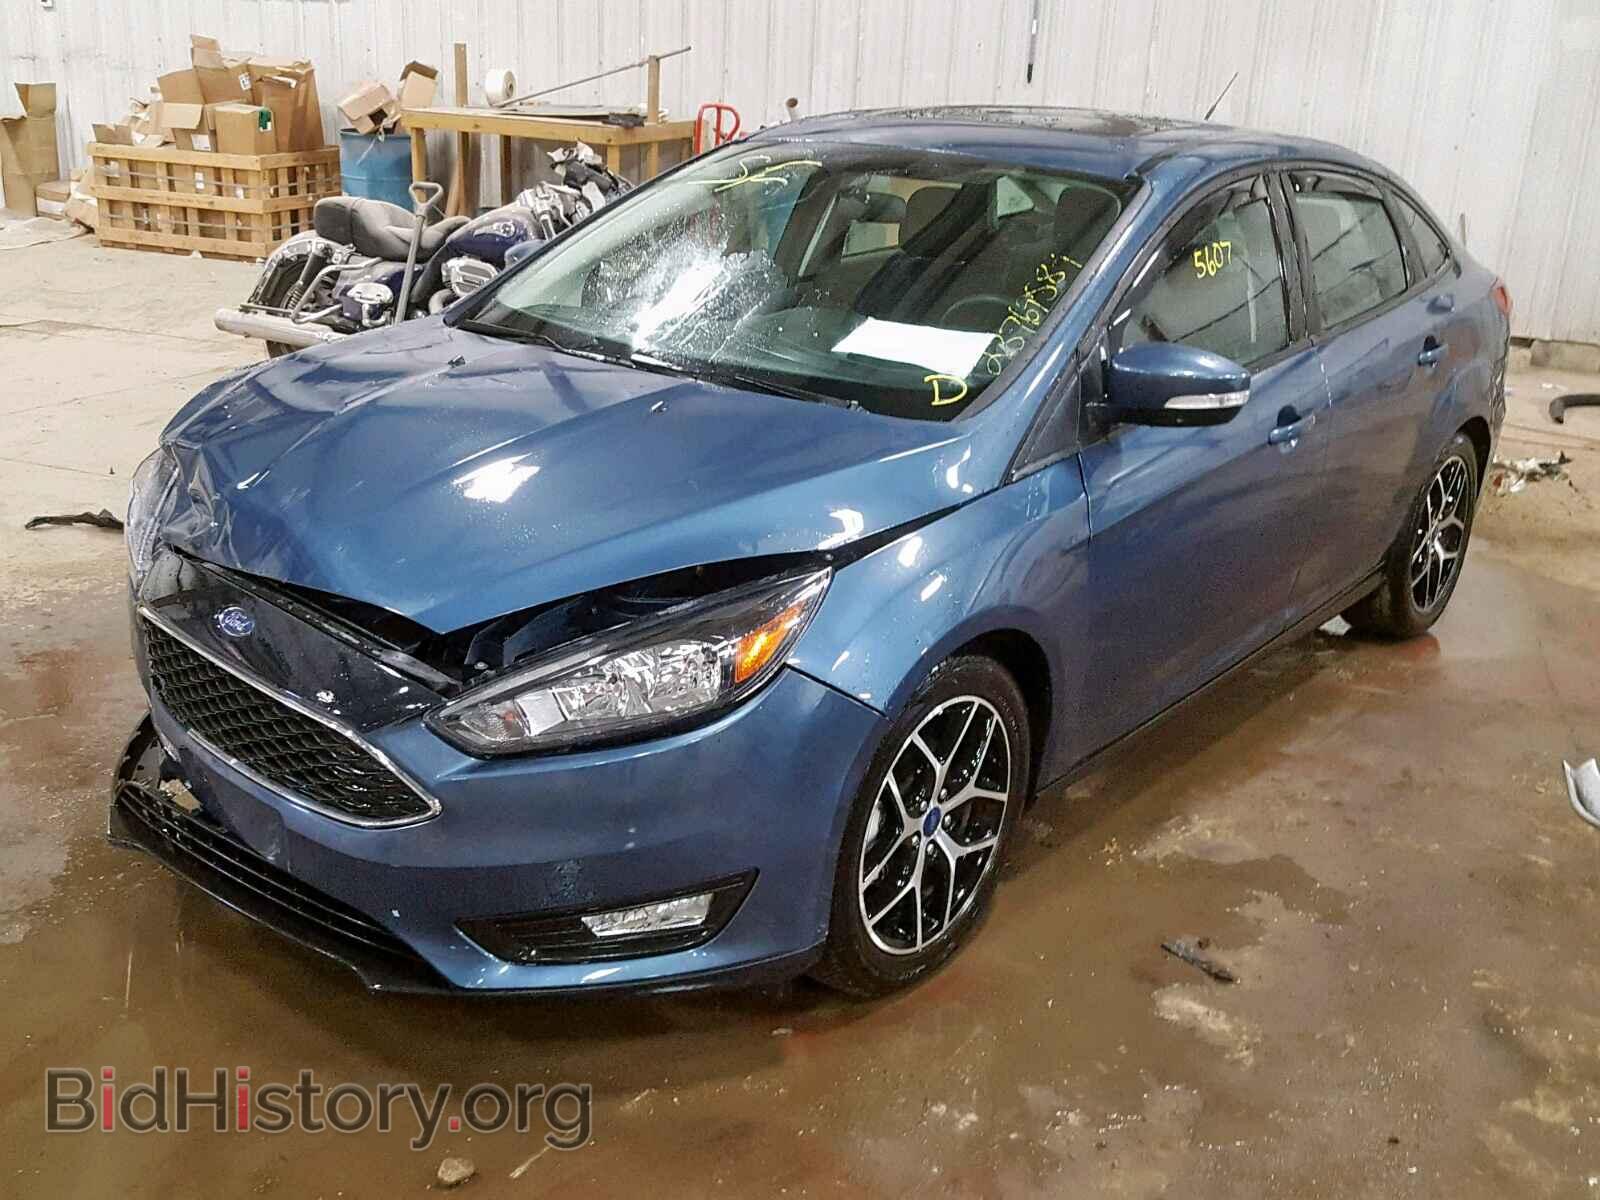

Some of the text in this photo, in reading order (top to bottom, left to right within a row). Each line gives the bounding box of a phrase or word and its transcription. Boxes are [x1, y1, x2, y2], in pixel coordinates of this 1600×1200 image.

[1193, 241, 1232, 279] 5607
[923, 373, 968, 407] D
[222, 609, 252, 632] Ford
